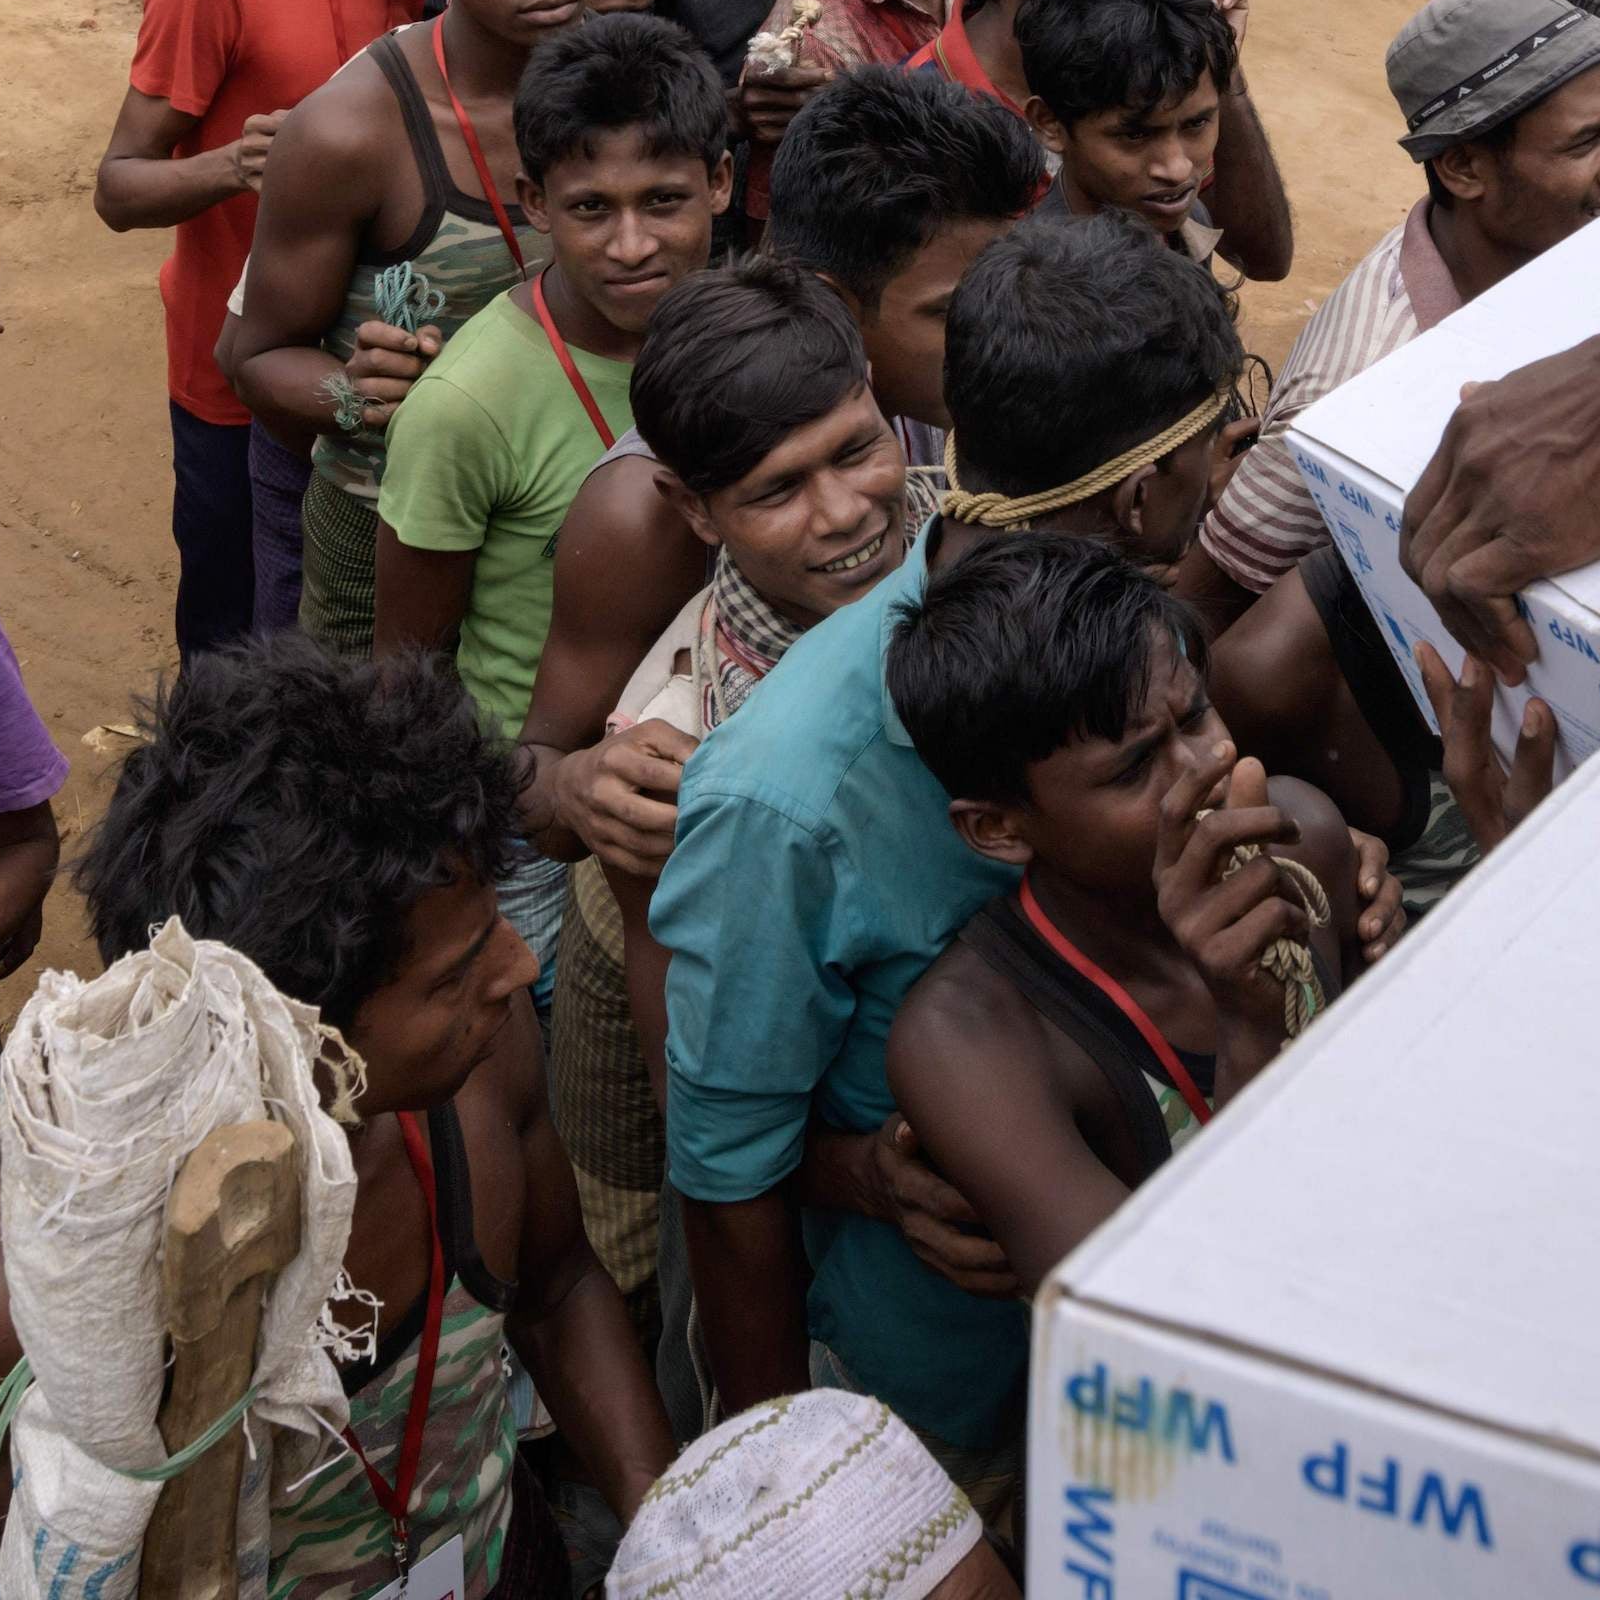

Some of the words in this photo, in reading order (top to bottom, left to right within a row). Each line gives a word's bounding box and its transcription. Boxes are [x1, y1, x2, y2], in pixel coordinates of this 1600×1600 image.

[1338, 484, 1376, 518] WFP
[1065, 1361, 1237, 1465] WFP
[1063, 1485, 1114, 1600] WF
[1301, 1441, 1494, 1549] WFP
